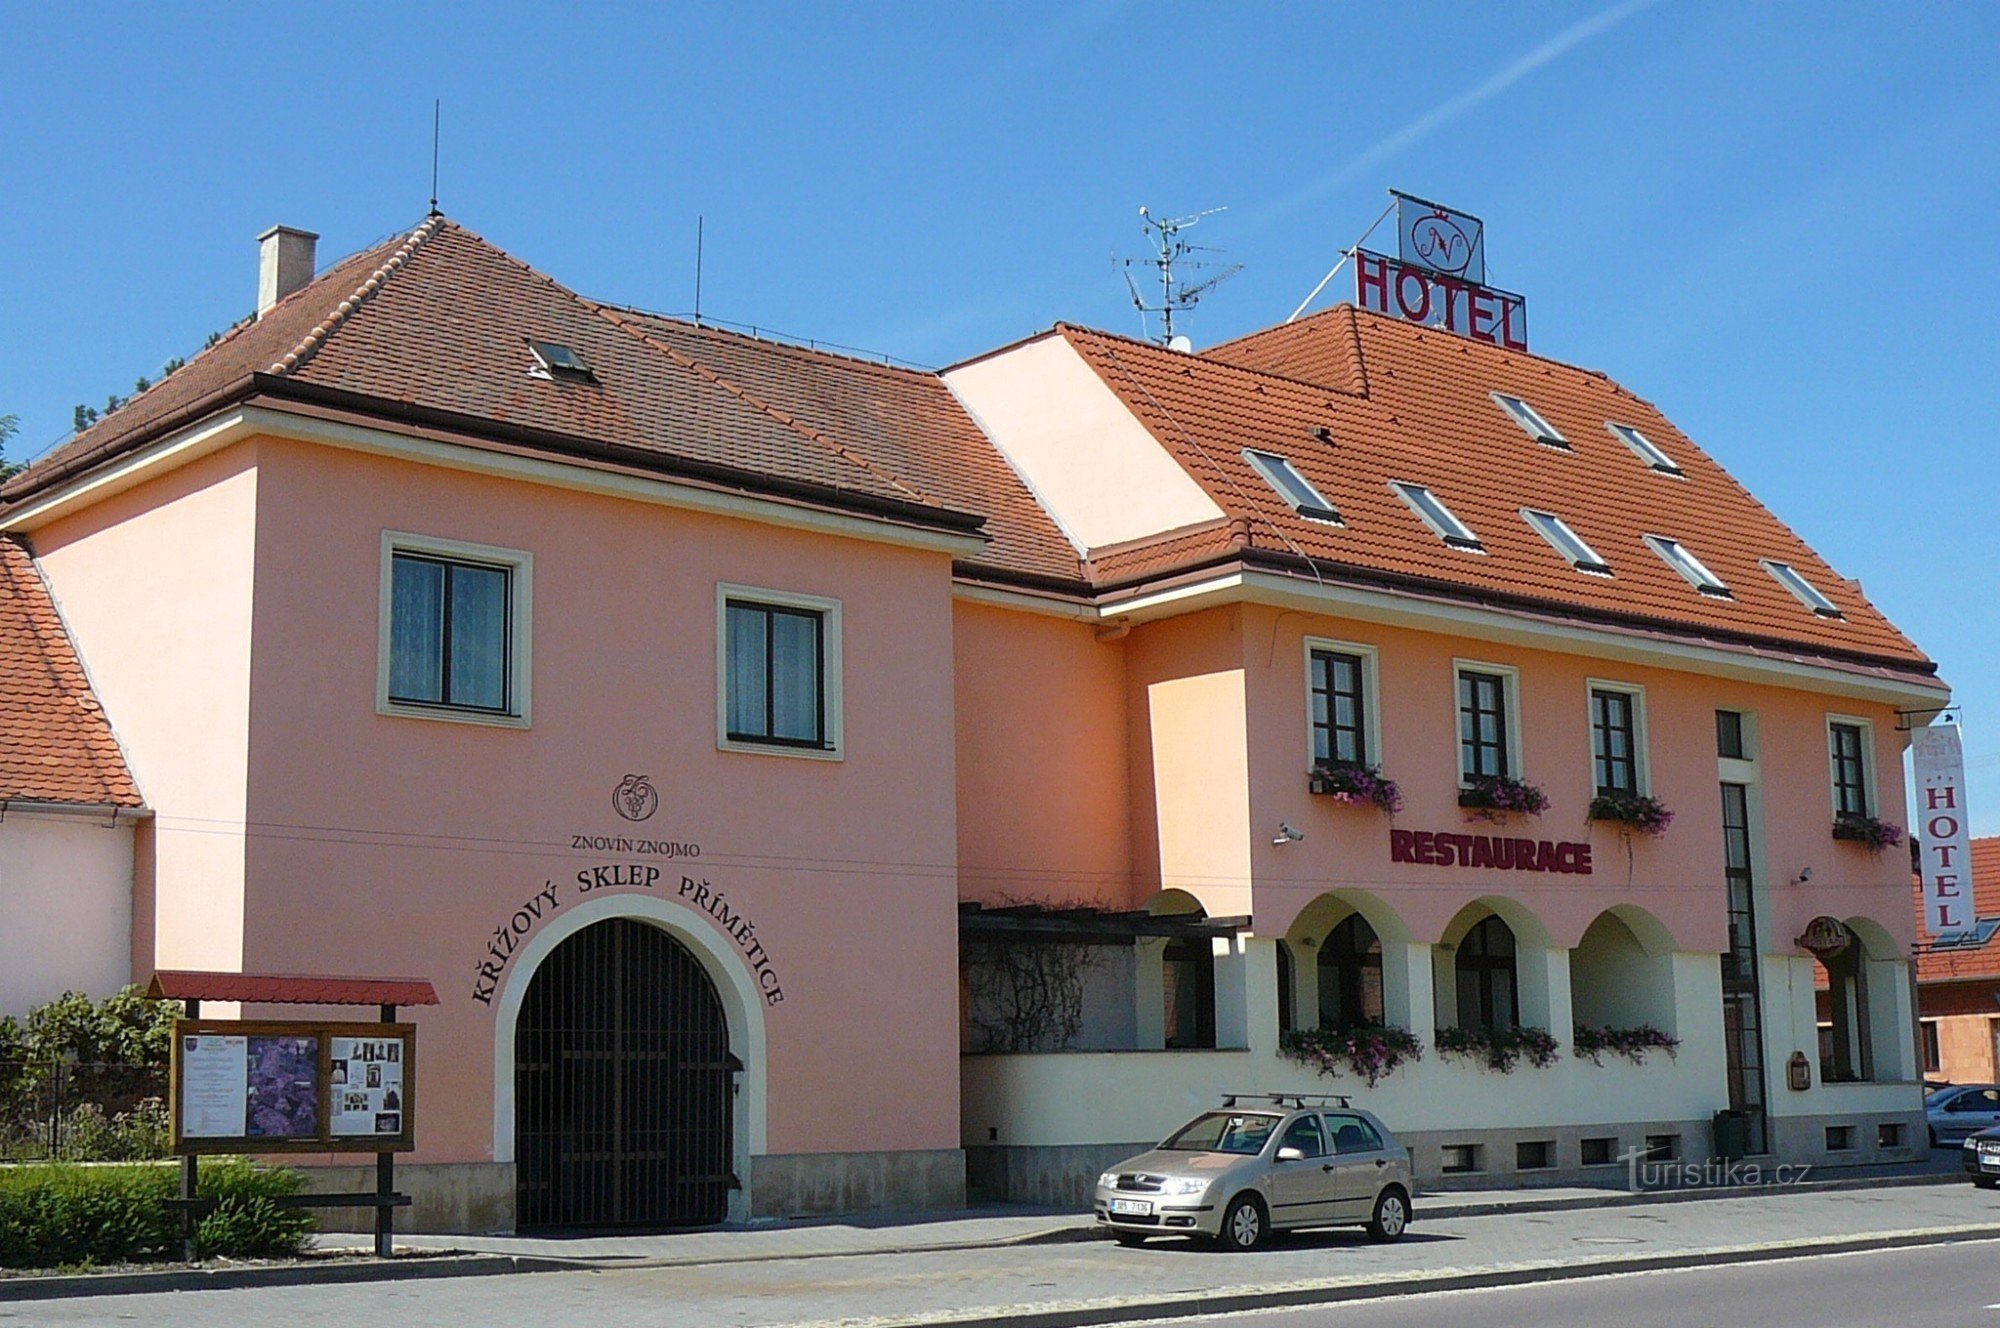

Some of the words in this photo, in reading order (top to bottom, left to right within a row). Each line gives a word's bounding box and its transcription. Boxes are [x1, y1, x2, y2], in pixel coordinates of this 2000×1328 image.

[1357, 251, 1528, 353] HOTEL
[571, 833, 634, 852] ZNOVÍN
[637, 840, 701, 859] ZNOJMO
[1390, 829, 1593, 875] RESTAURACE
[1926, 786, 1961, 927] HOTEL
[472, 880, 562, 1007] KŘÍŽOVÝ
[577, 864, 660, 893] SKLEP
[678, 875, 785, 1007] PŘÍMĚTICE
